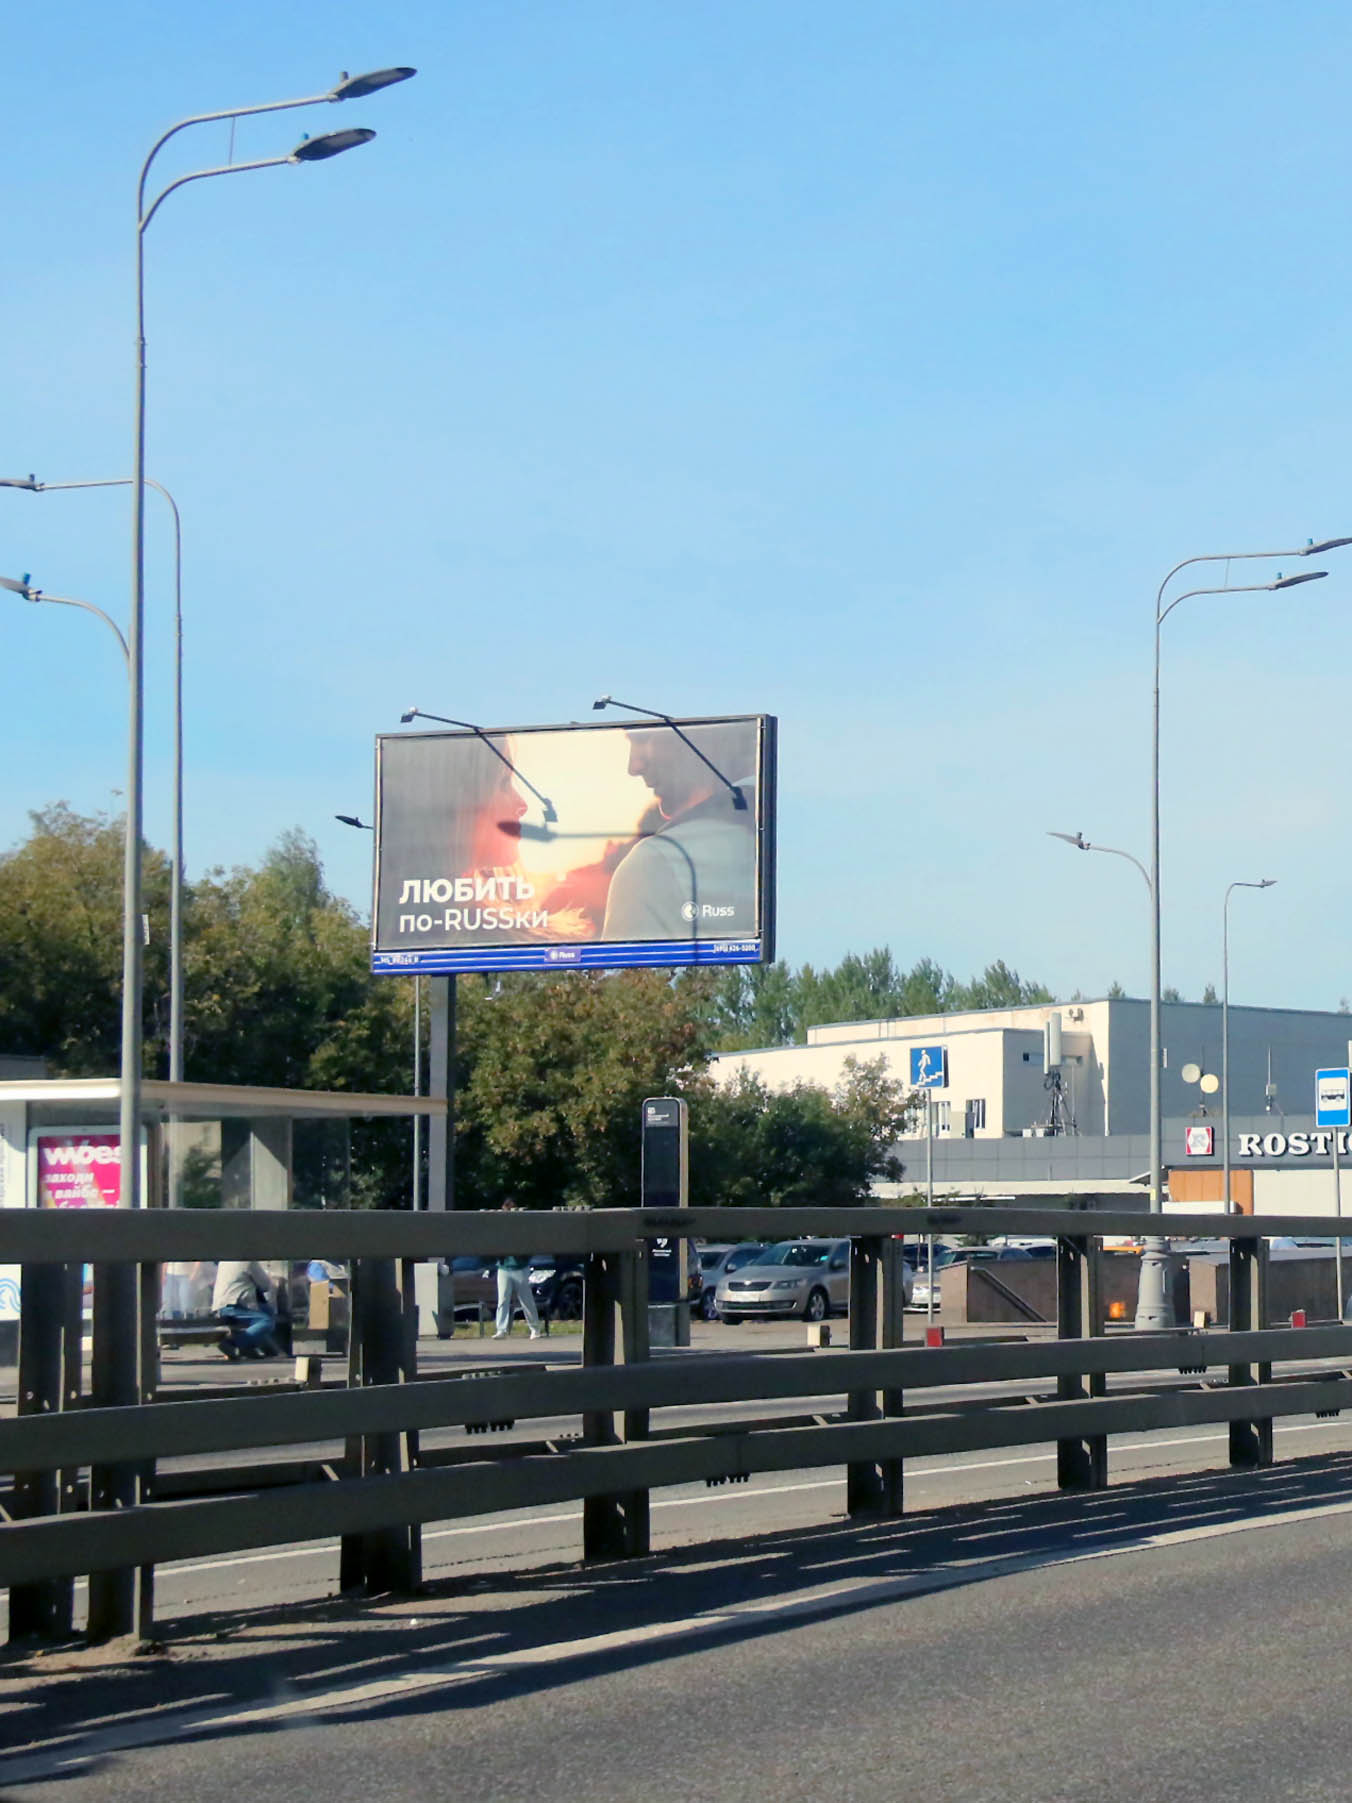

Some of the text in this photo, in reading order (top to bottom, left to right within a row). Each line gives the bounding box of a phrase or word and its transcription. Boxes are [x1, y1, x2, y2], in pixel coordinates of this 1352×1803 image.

[399, 875, 535, 904] ЛЮБИТЬ
[400, 907, 548, 933] по-RUSSки
[702, 904, 736, 917] Russ
